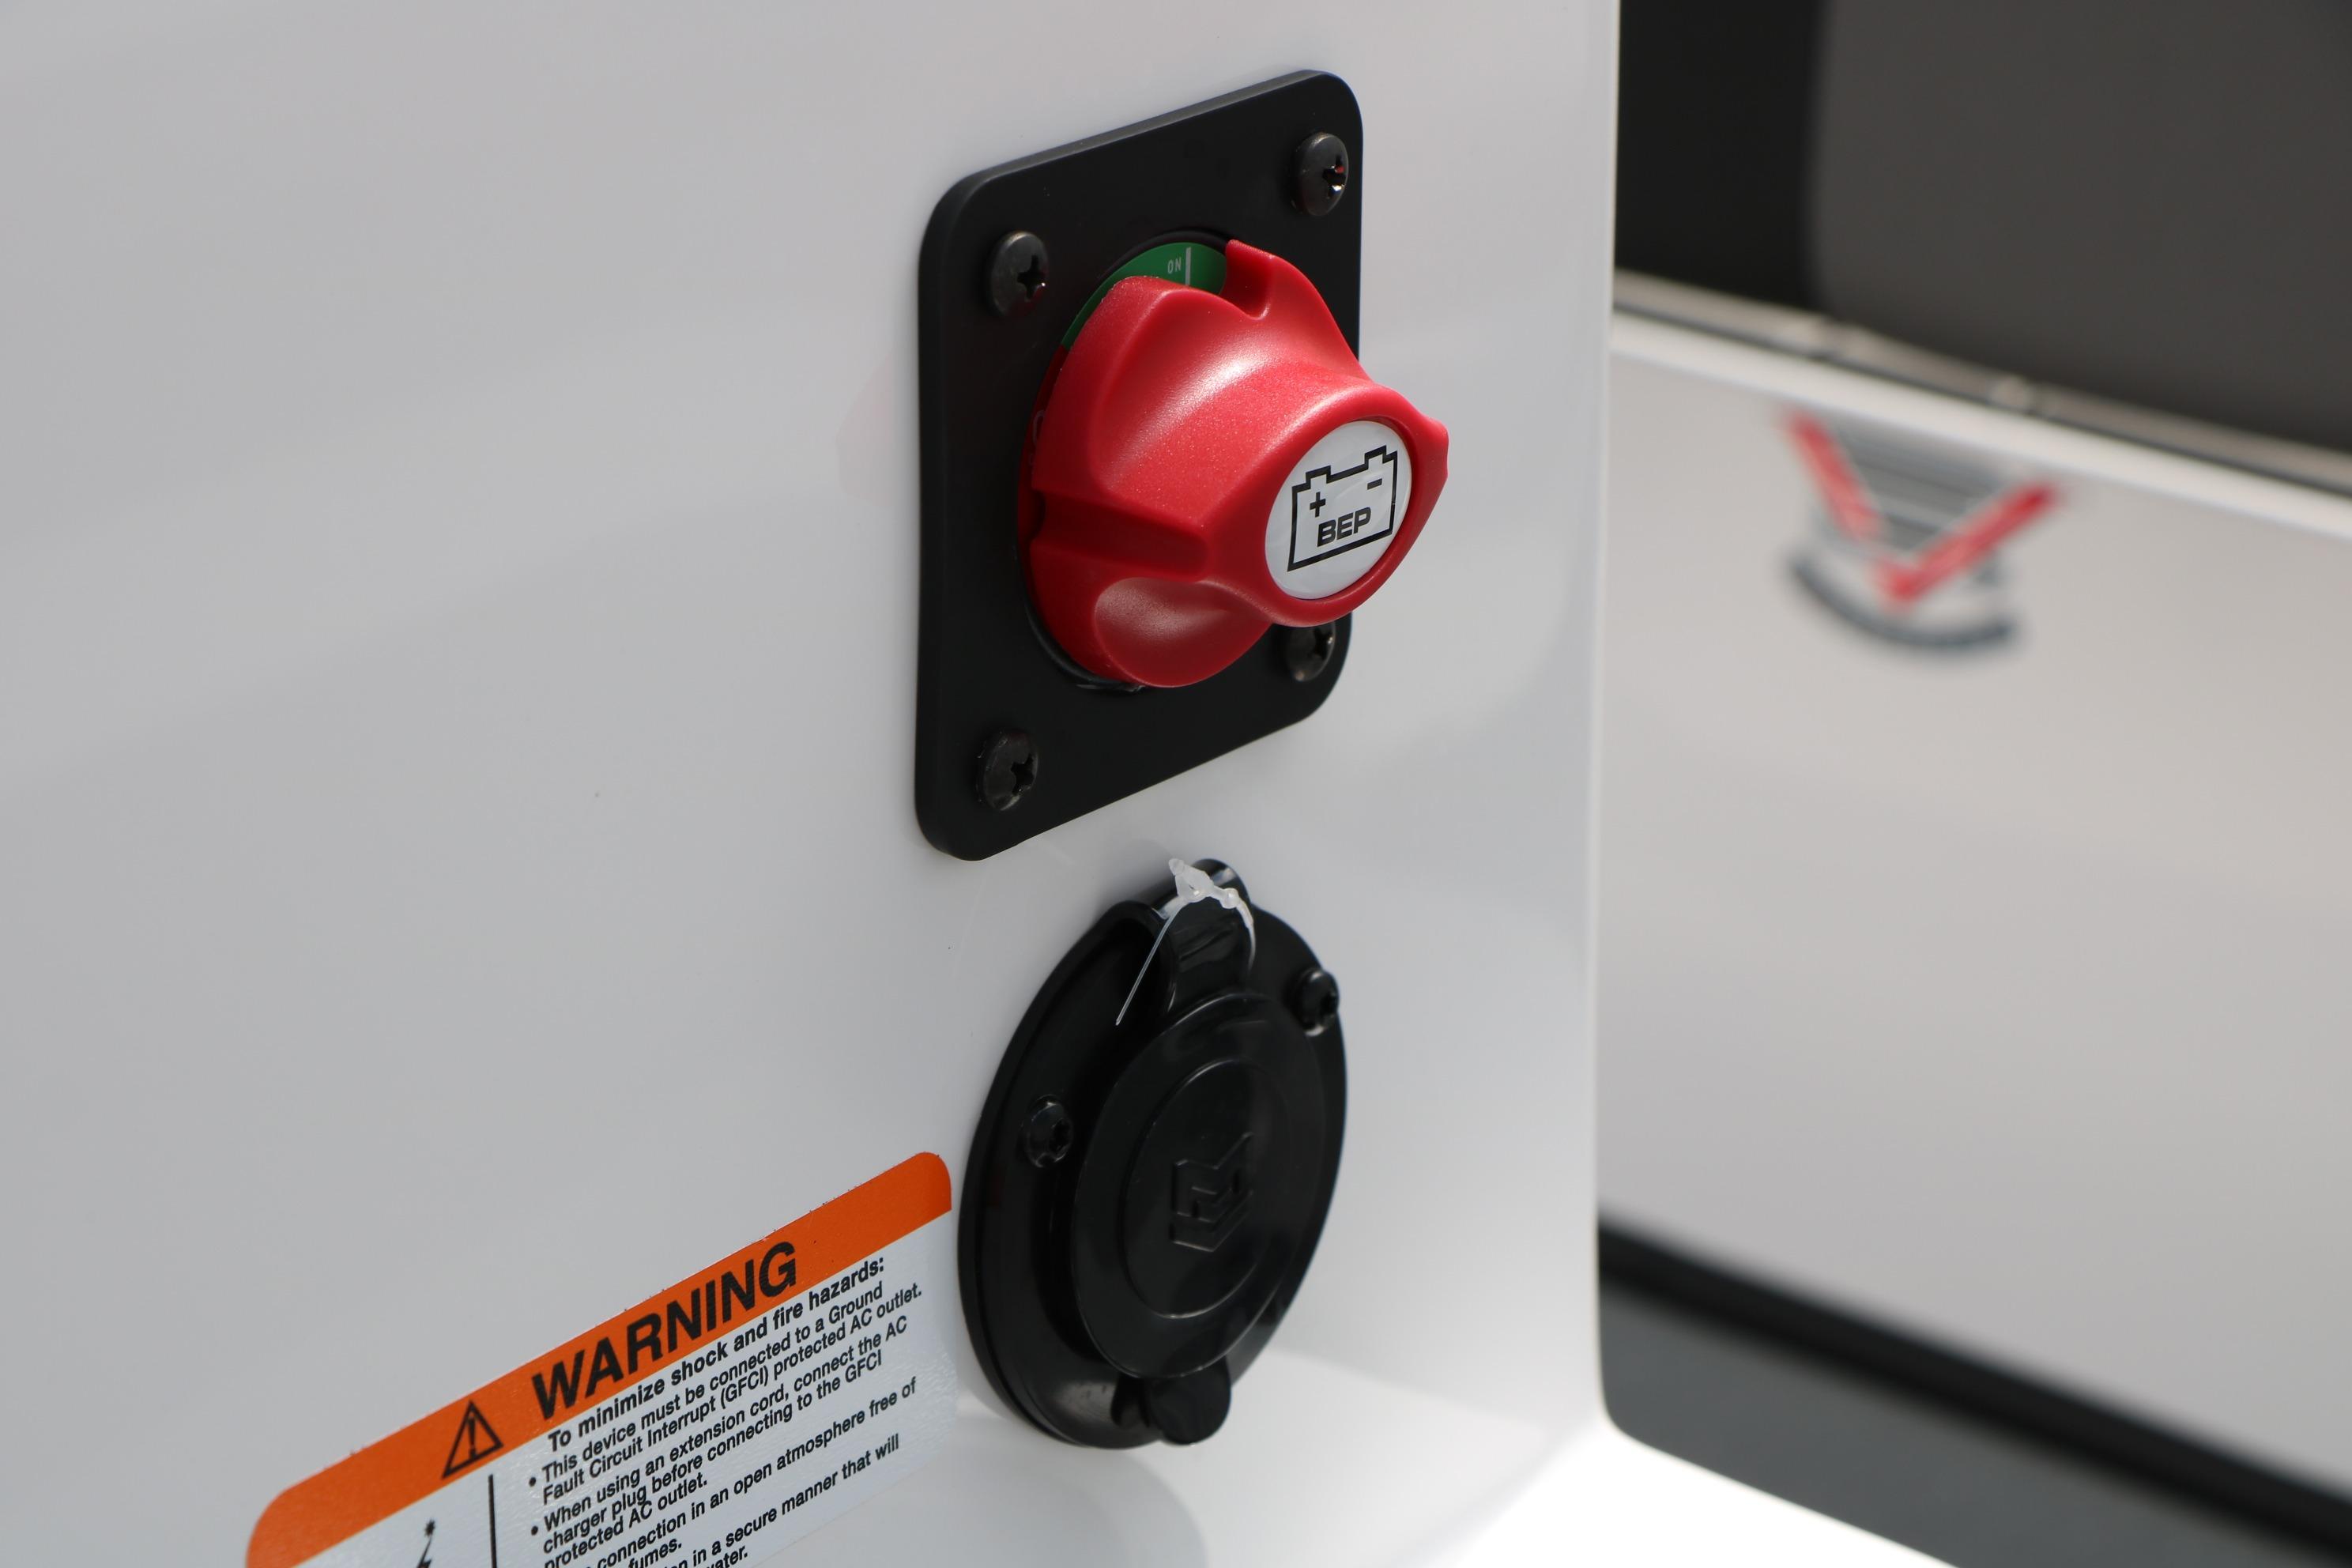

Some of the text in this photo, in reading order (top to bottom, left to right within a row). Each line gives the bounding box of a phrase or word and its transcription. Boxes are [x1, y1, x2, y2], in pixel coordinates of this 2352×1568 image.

[1167, 257, 1182, 274] ON
[1317, 507, 1371, 547] BEP
[532, 1242, 796, 1420] WARNING
[542, 1281, 883, 1483] This device must be connected to a Ground
[543, 1283, 922, 1505] Fault Circuit Interrupt (GFCI) protected AC outlet.
[548, 1257, 884, 1452] To minimize shock and fire hazards:
[544, 1315, 907, 1532] When using an extension cord, connect the AC
[544, 1350, 882, 1553] charger plug before connecting to the GFCI
[597, 1377, 916, 1568] connection in an open atmosphere free of
[629, 1500, 652, 1528] AC
[658, 1472, 707, 1510] outlet.
[693, 1434, 899, 1566] in a secure manner that will
[707, 1546, 748, 1568] ater.
